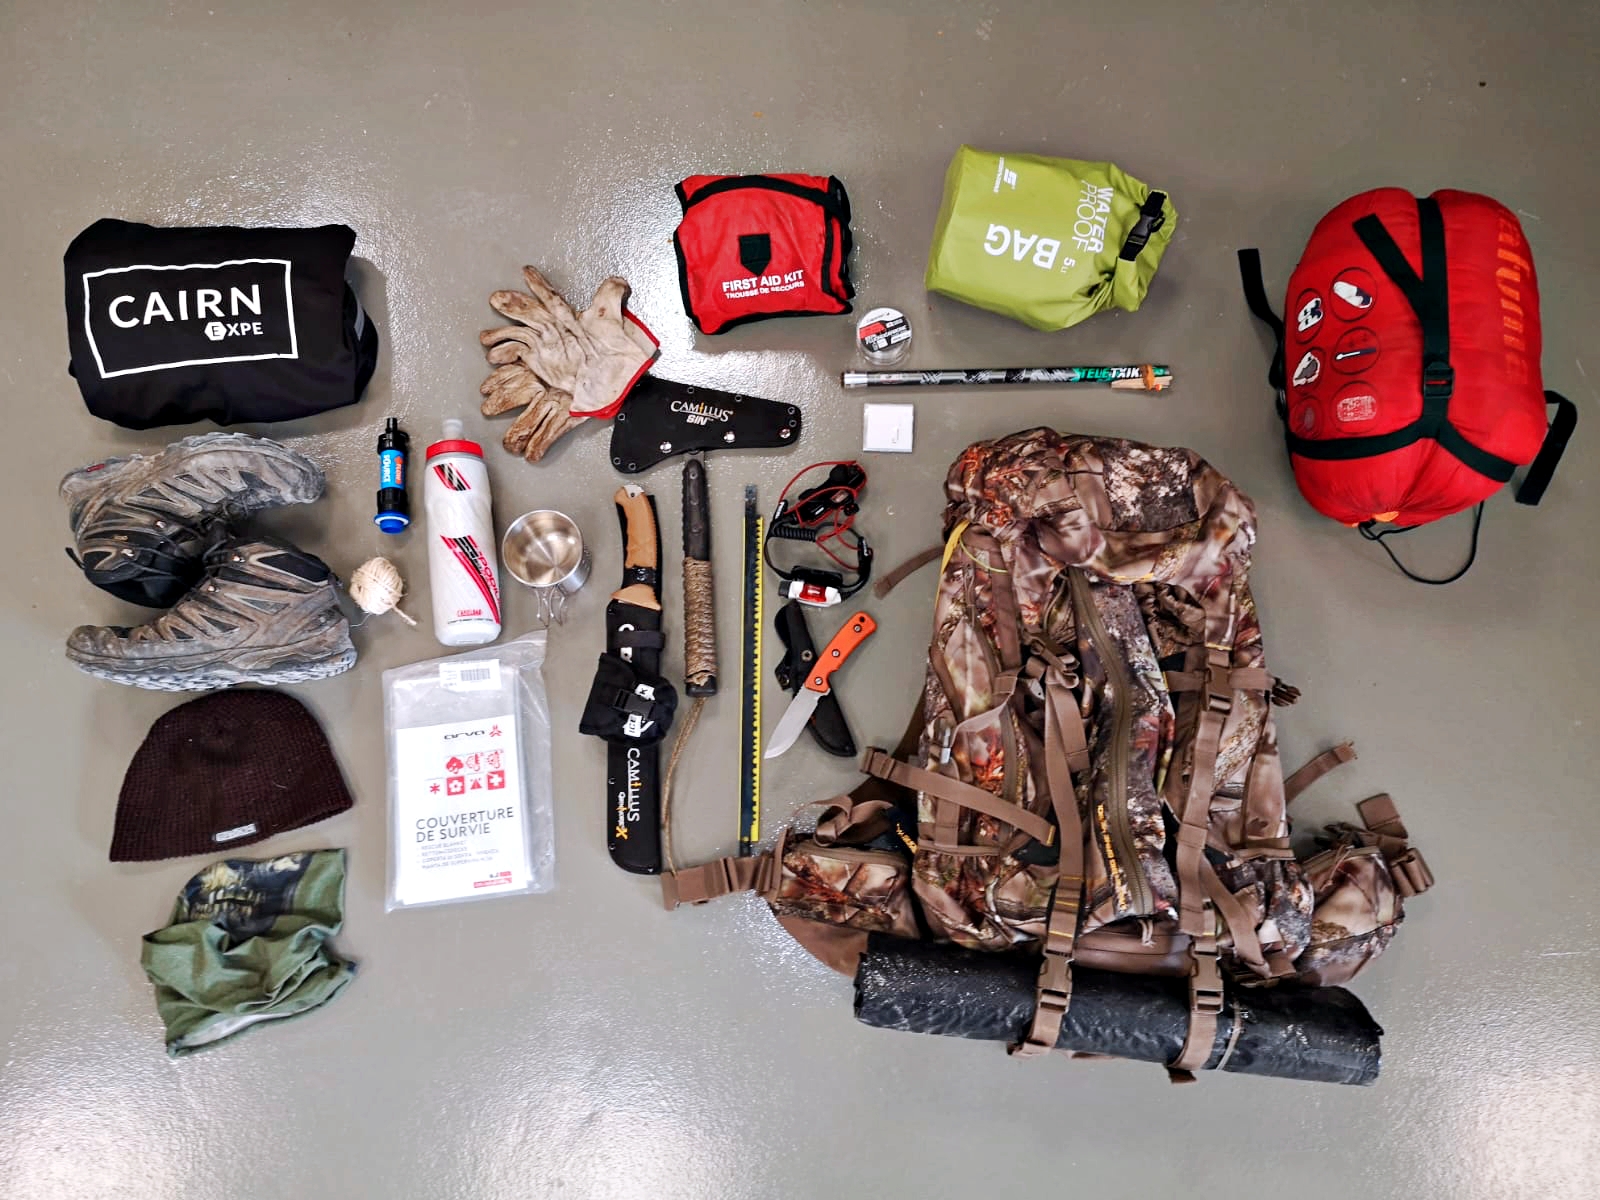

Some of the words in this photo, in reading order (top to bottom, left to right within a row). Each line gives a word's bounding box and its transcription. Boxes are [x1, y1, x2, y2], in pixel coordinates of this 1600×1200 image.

[1071, 180, 1098, 253] PROOF
[1087, 187, 1115, 254] WATER
[983, 223, 1061, 270] BAG
[723, 278, 757, 292] FIRST
[760, 275, 782, 287] AID
[784, 269, 805, 284] KIT
[726, 289, 759, 299] TROUSSE
[771, 281, 805, 292] SECOURS
[108, 284, 263, 329] CAIRN
[1495, 210, 1530, 384] afuma
[204, 320, 264, 342] EXPE
[1080, 366, 1143, 380] TELETXIK
[670, 400, 730, 422] CAMILLUS
[443, 731, 485, 740] arva
[626, 747, 641, 823] CAMILLUS
[415, 807, 514, 829] COUVERTURE
[415, 829, 436, 843] DE
[440, 822, 491, 840] SURVIE
